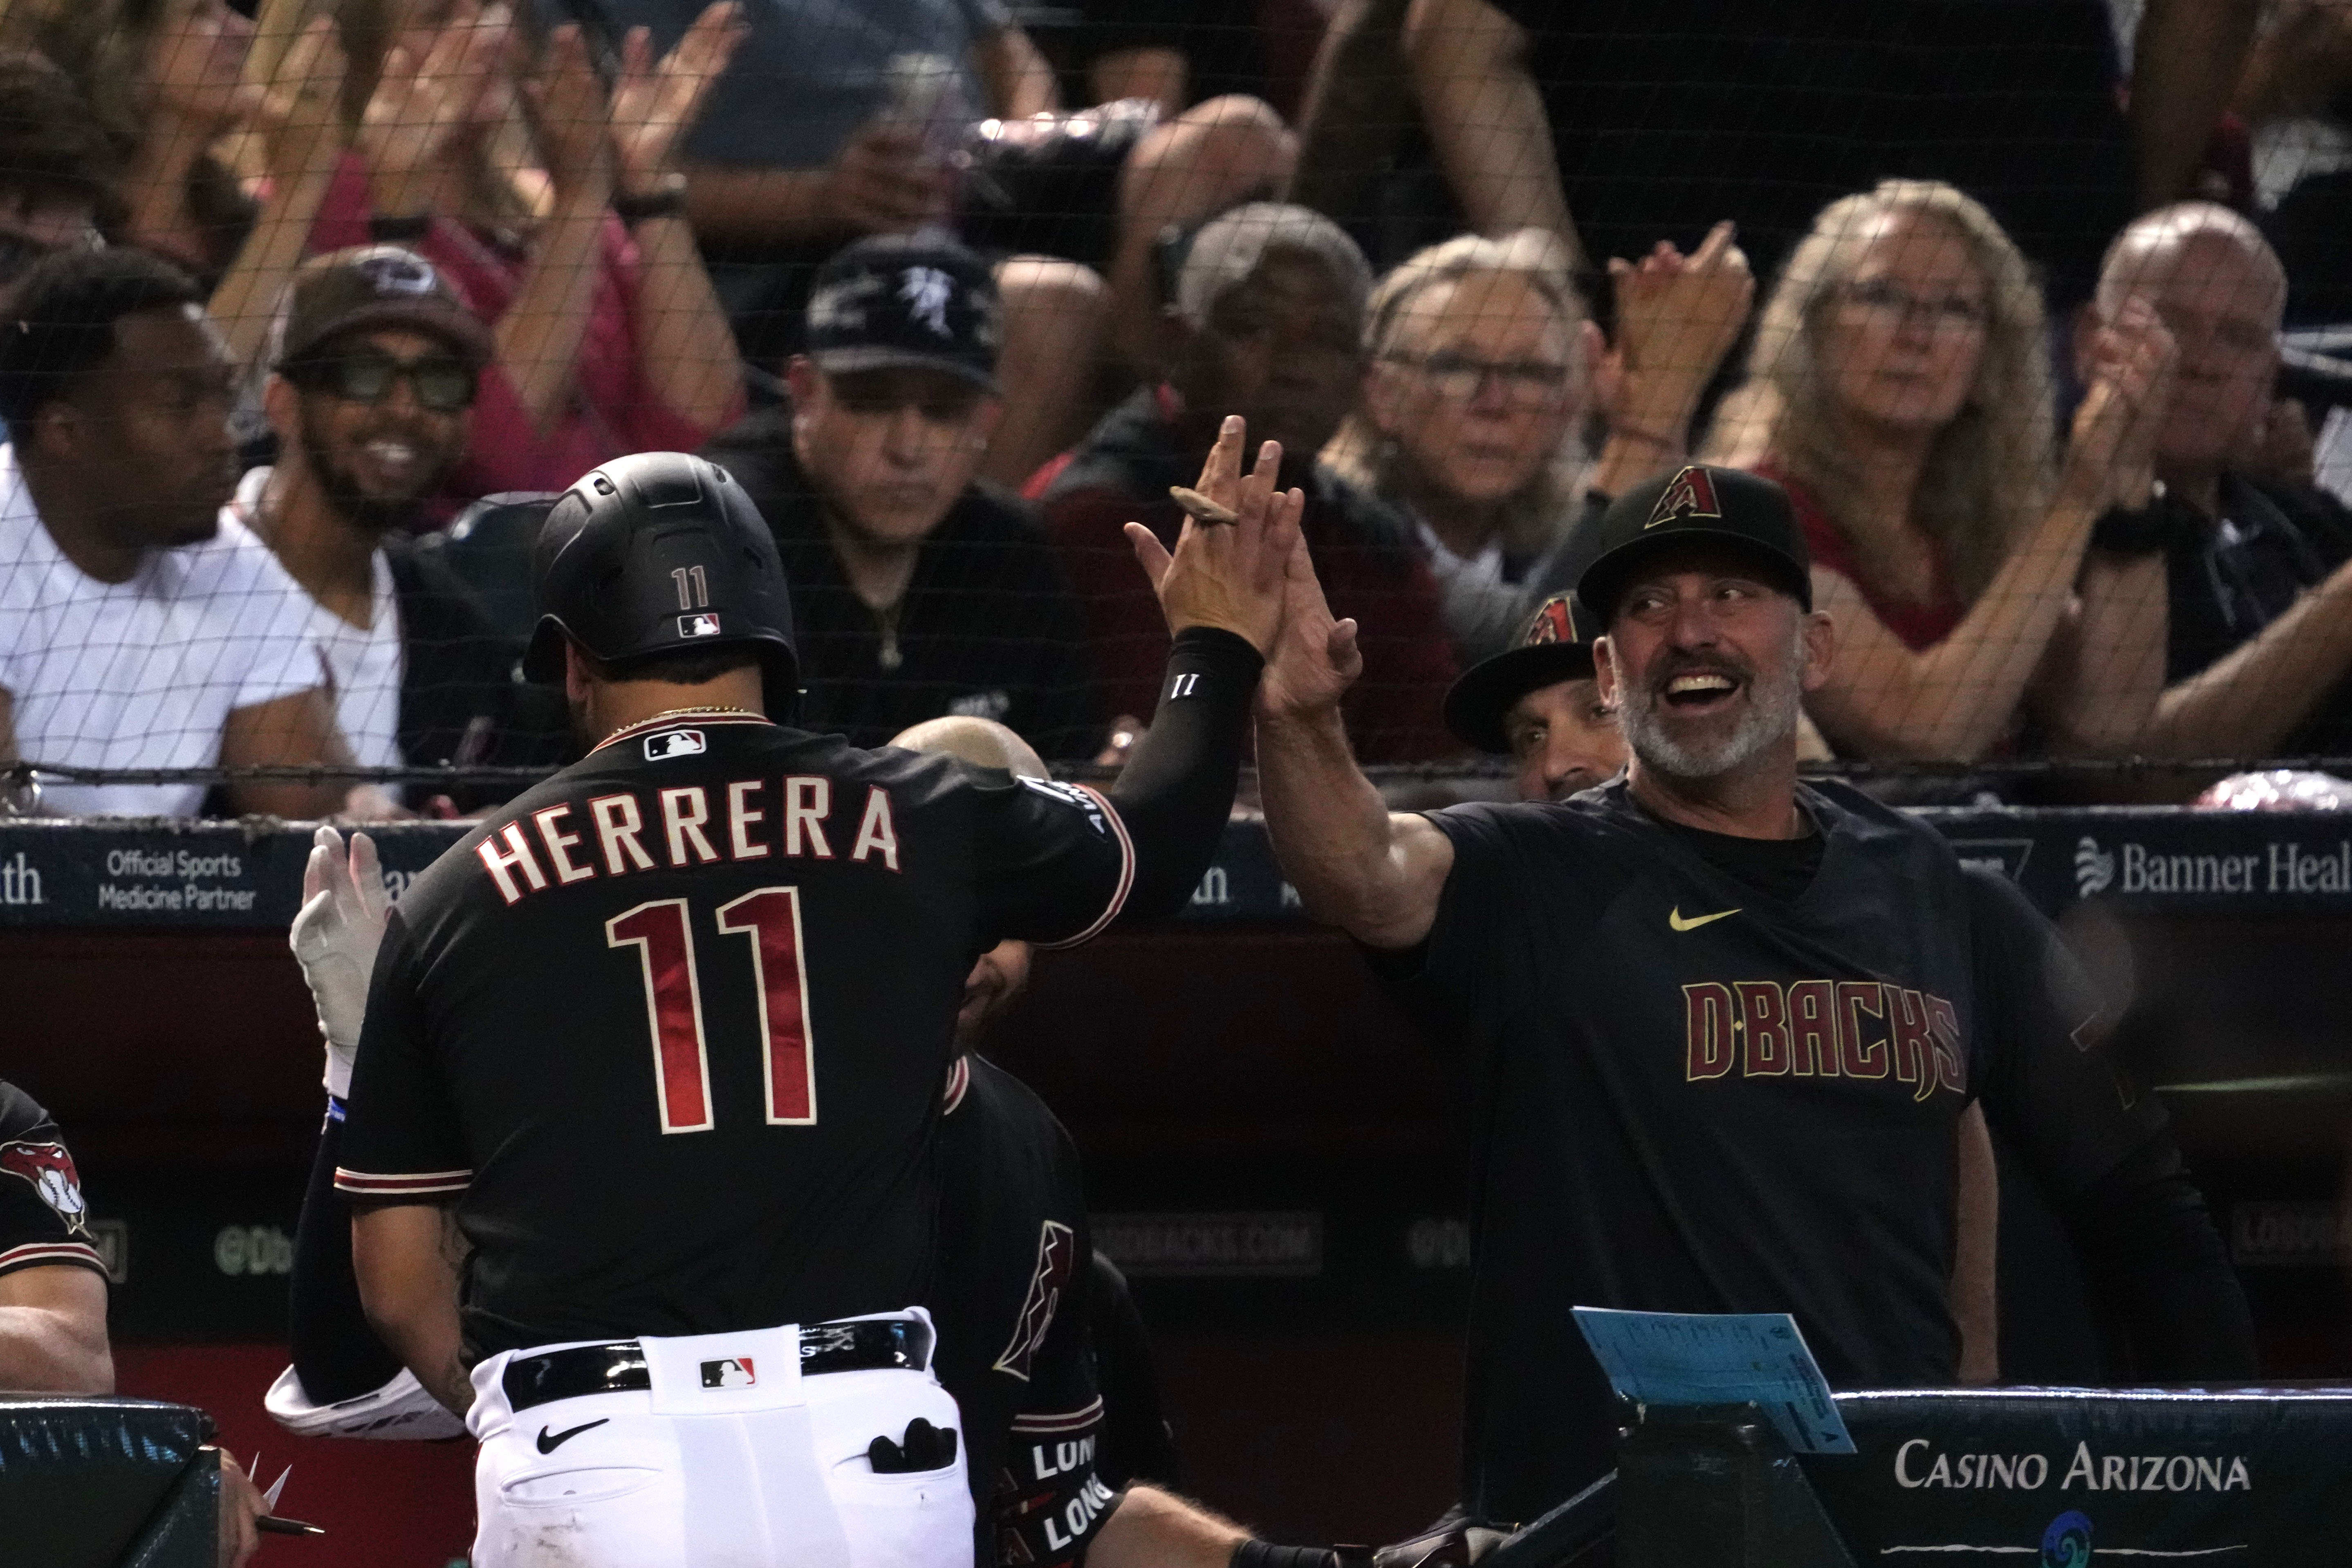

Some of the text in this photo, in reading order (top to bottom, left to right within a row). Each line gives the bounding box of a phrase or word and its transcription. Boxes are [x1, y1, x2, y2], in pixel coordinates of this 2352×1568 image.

[671, 565, 708, 610] 11
[475, 774, 902, 906] HERRERA
[107, 849, 242, 882] Official Sports
[2123, 840, 2352, 894] Banner Heal
[98, 883, 257, 911] Medicine Partner
[605, 885, 818, 1135] 11
